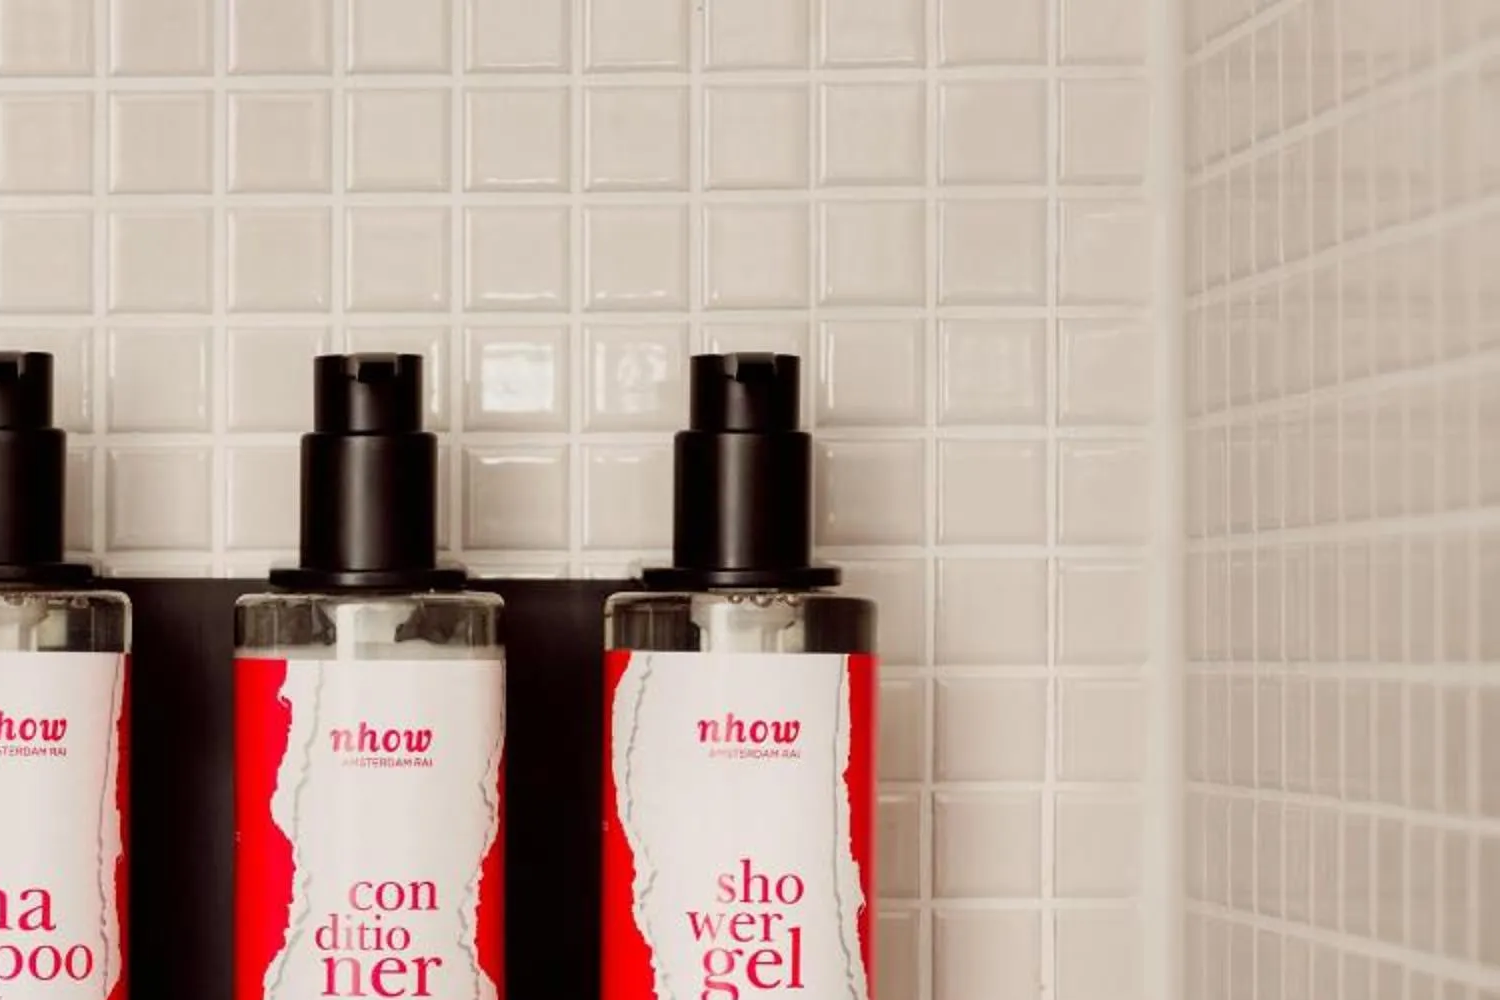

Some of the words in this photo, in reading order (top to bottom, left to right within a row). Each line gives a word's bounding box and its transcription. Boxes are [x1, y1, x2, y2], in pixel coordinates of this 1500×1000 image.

[330, 721, 433, 752] nhow
[697, 712, 801, 744] nhow
[342, 757, 412, 767] AMSTERDAM
[349, 880, 439, 911] con
[717, 858, 804, 905] sho
[315, 913, 411, 951] ditio
[686, 911, 783, 943] wer
[321, 954, 443, 997] ner
